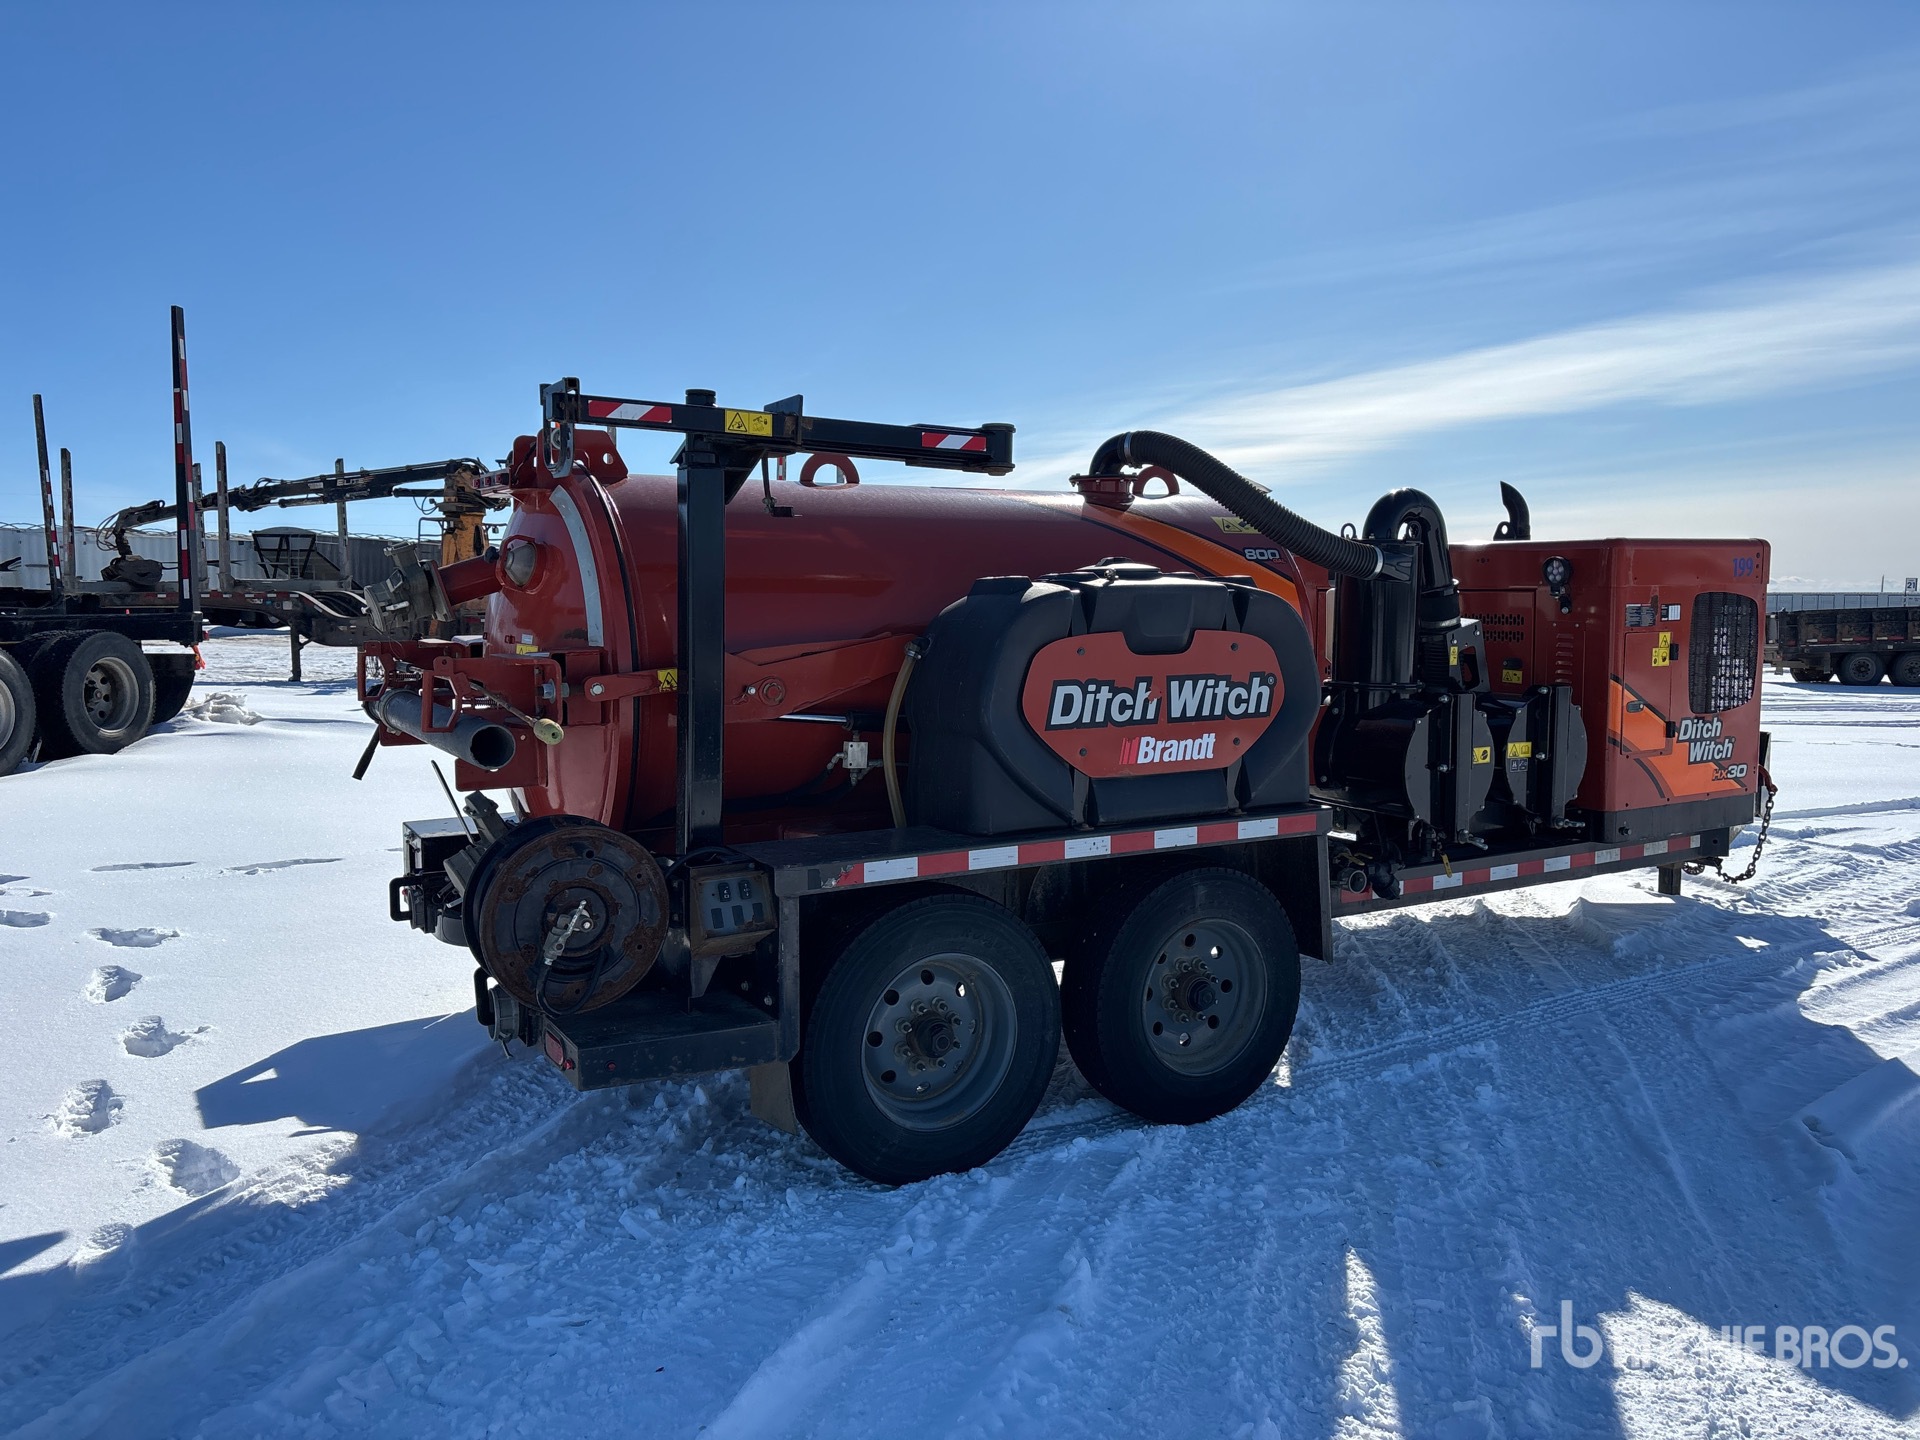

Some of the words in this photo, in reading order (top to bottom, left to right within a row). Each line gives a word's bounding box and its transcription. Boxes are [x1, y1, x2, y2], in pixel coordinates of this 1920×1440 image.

[1244, 548, 1280, 560] 800
[1733, 557, 1753, 577] 199
[1050, 682, 1159, 726] Ditch
[1678, 717, 1722, 741] Ditch
[1137, 733, 1216, 764] Brandt
